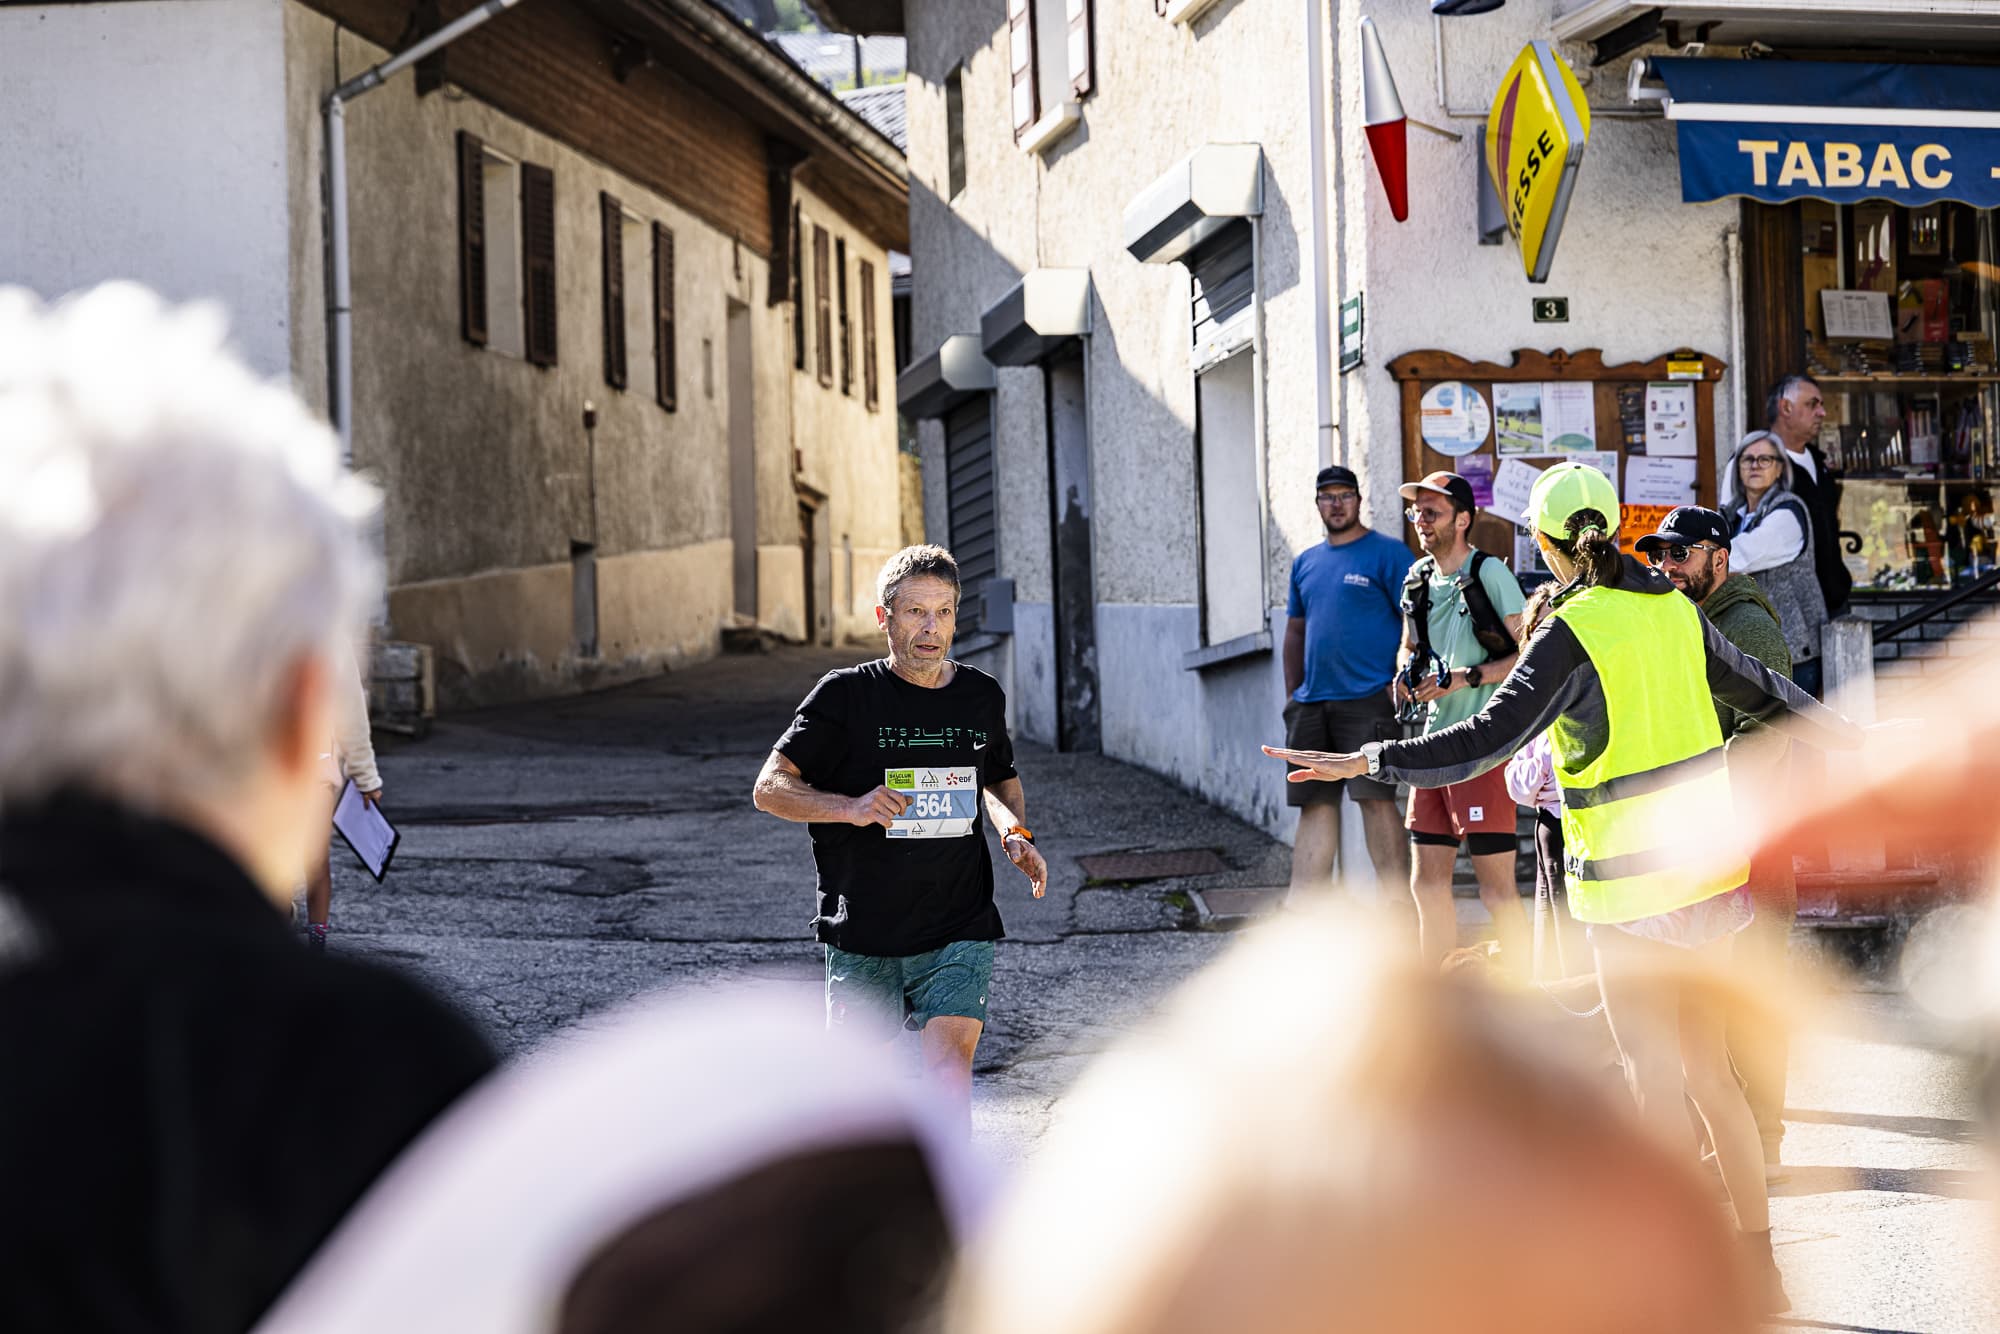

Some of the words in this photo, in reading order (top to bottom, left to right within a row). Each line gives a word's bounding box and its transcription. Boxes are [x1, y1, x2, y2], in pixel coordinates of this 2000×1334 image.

[1738, 140, 1953, 189] TABAC
[1545, 301, 1557, 318] 3
[879, 727, 908, 737] IT'S
[914, 727, 961, 737] JUST
[967, 729, 988, 741] THE
[916, 792, 953, 817] 564
